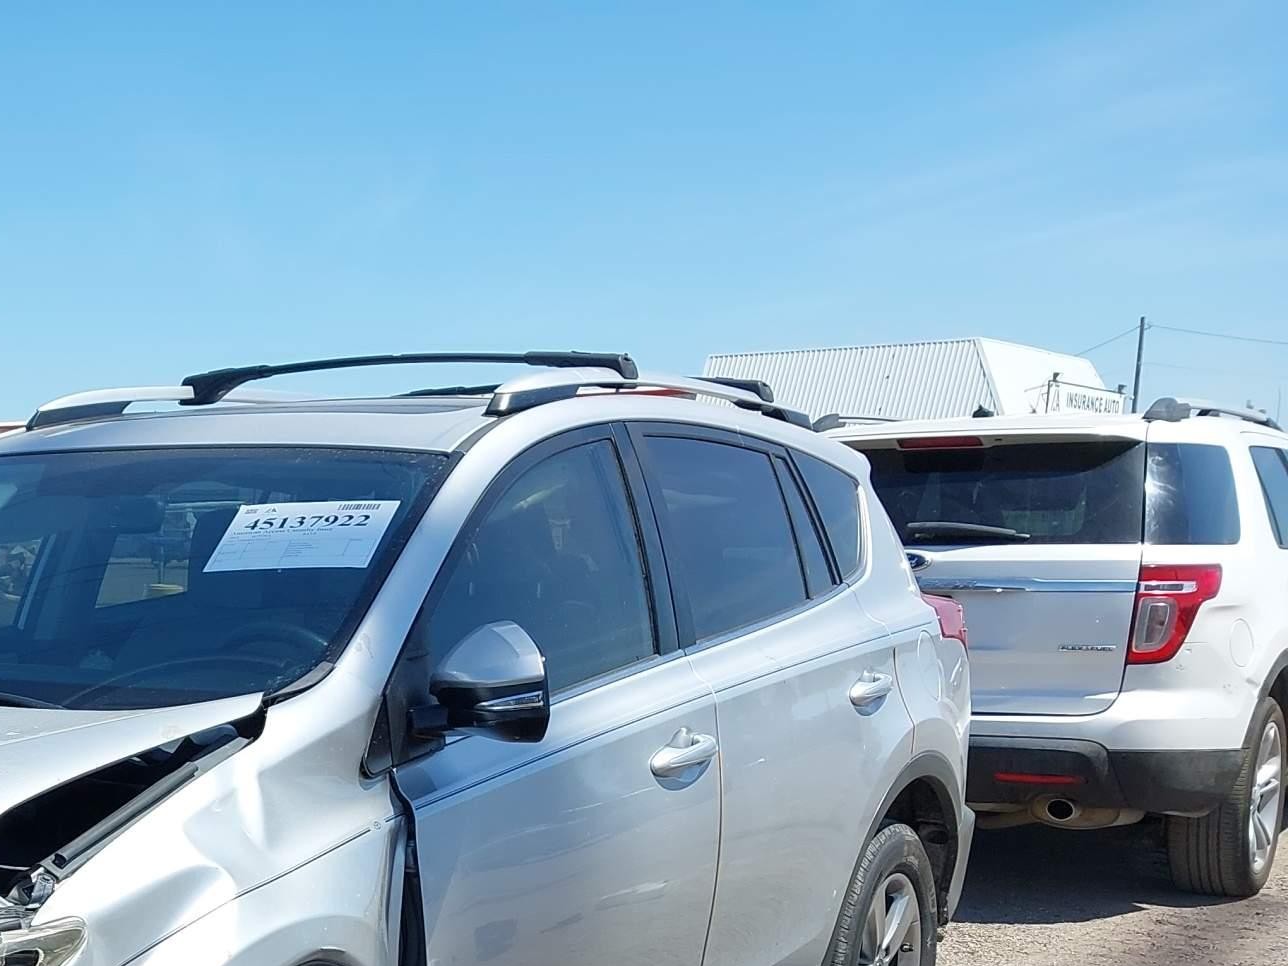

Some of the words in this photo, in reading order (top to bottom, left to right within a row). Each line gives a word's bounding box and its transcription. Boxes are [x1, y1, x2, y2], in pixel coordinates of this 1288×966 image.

[1066, 391, 1103, 413] INSURANCE
[1104, 398, 1120, 414] AUTO
[244, 514, 371, 530] 45137922
